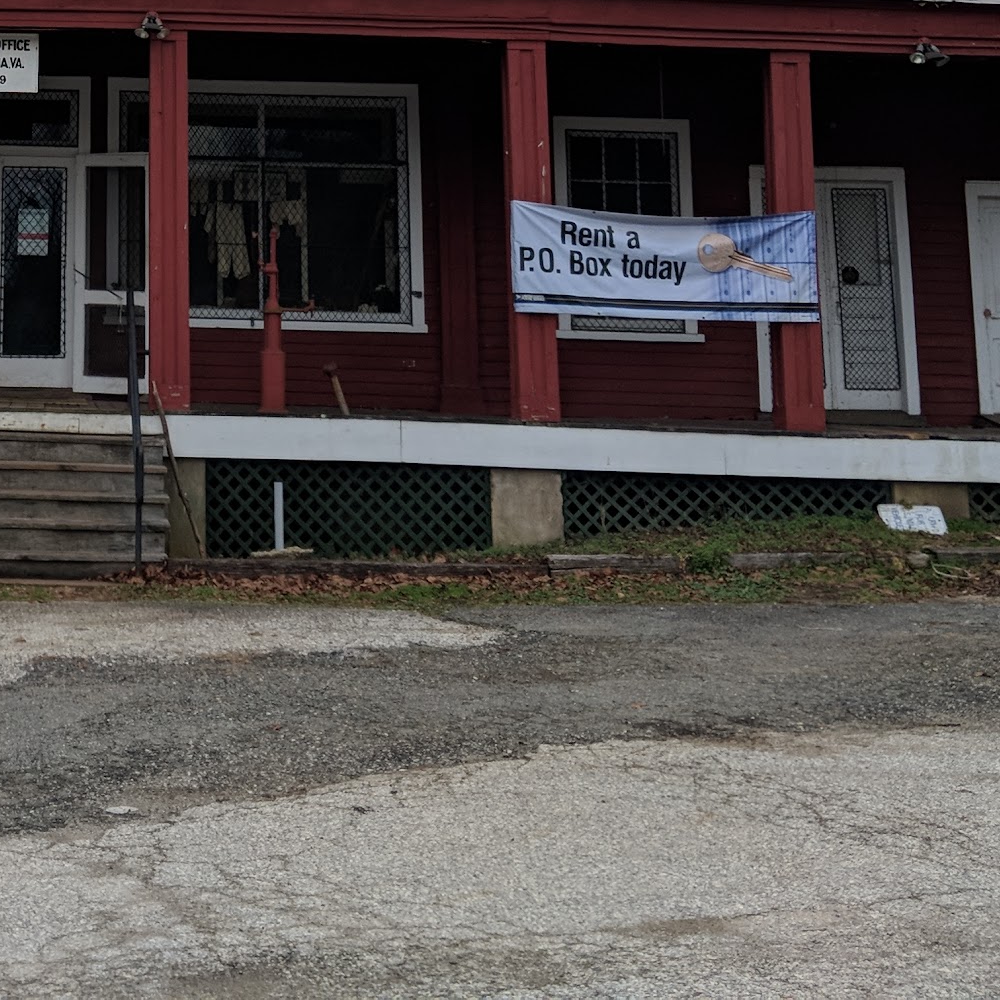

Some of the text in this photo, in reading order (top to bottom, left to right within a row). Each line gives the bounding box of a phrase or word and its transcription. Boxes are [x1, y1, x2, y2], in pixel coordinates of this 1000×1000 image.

[560, 220, 641, 249] Rent a
[518, 246, 687, 286] P.O. Box today
